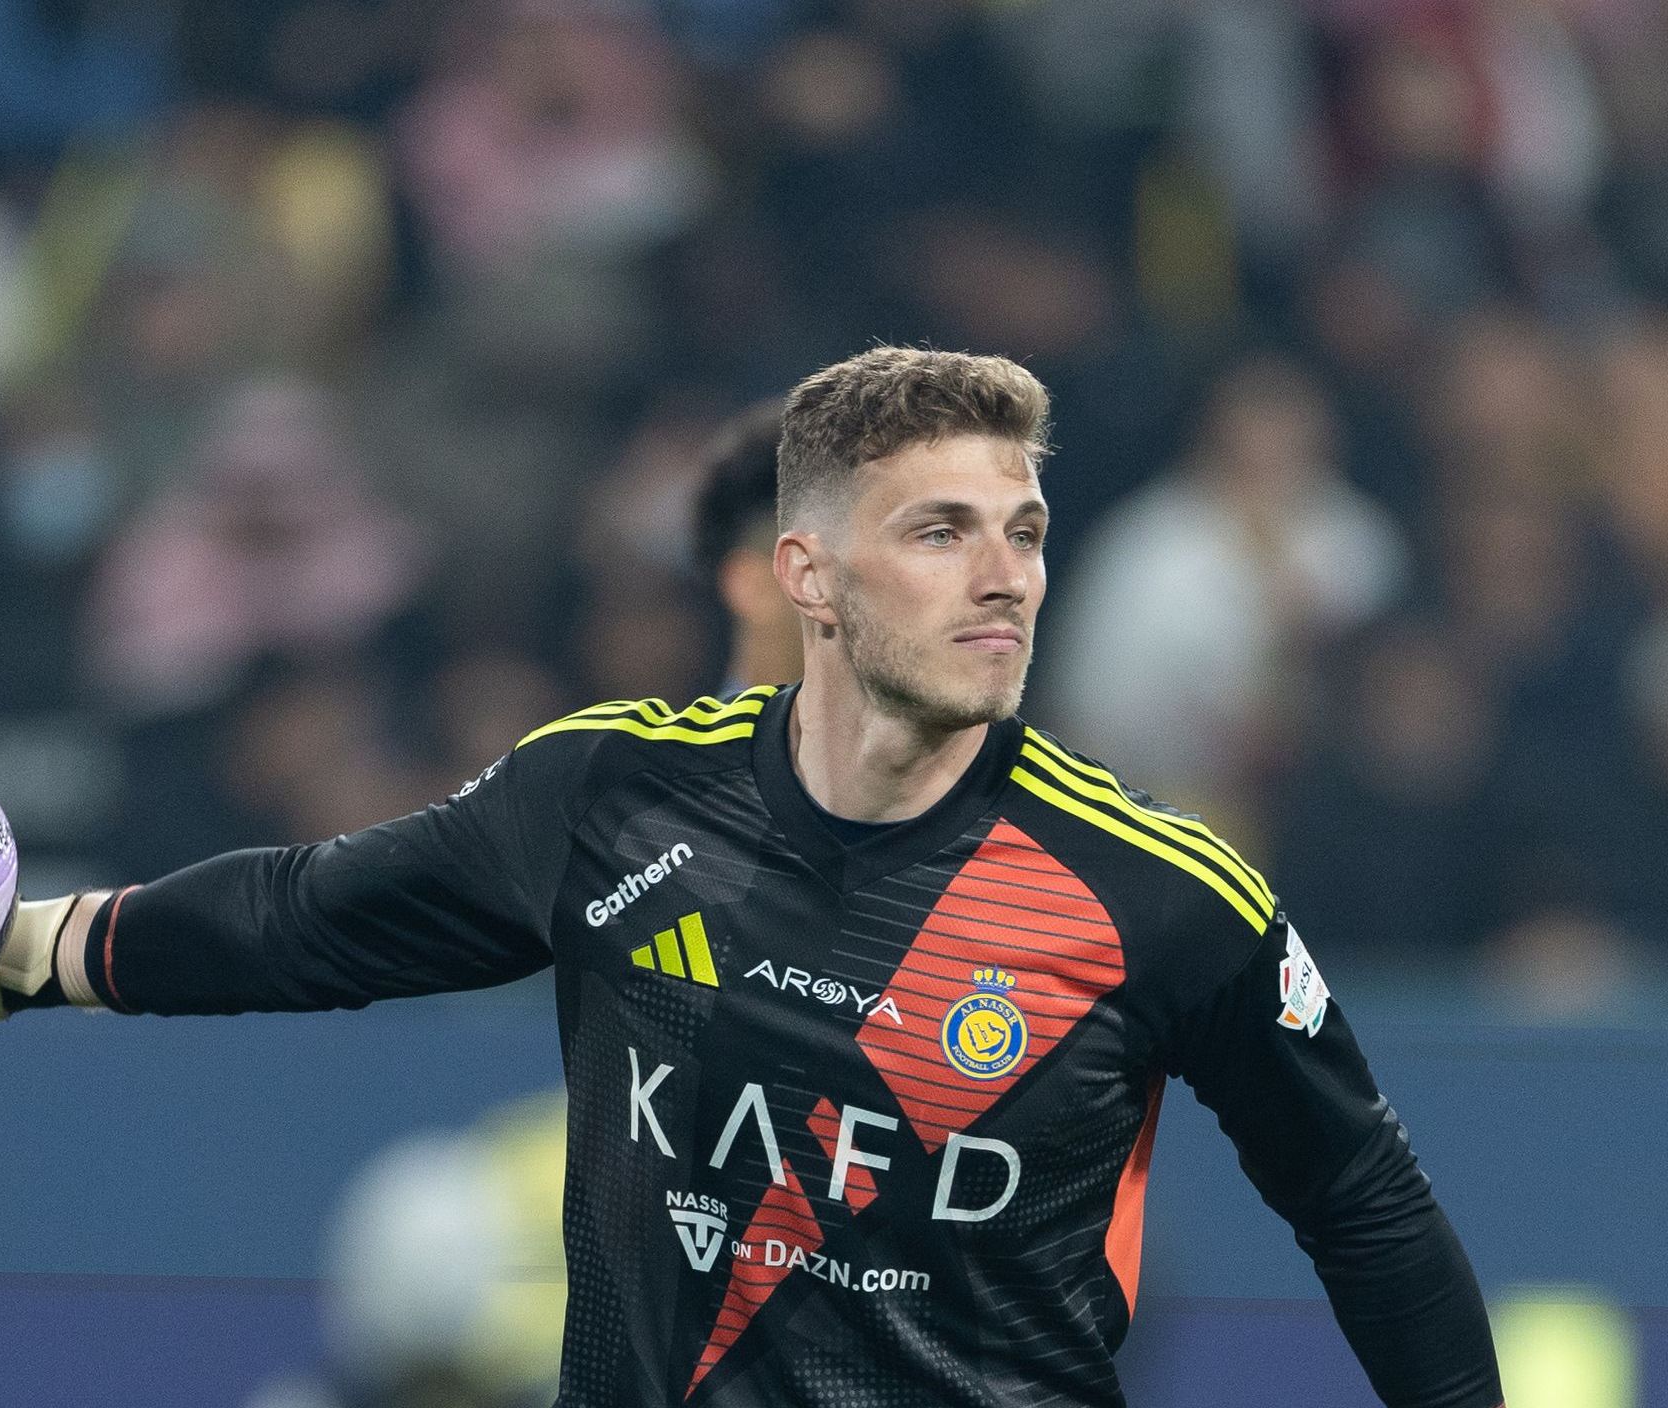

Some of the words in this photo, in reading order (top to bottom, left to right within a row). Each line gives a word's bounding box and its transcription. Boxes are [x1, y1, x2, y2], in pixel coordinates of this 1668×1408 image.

[585, 842, 694, 928] Gathern
[978, 999, 1018, 1027] NASSR
[952, 1045, 990, 1071] FOOTBALL
[992, 1054, 1014, 1070] CLUB
[628, 1045, 1022, 1223] KAFD
[665, 1189, 729, 1221] NASSR
[731, 1240, 752, 1260] ON
[764, 1238, 932, 1293] DAZN.com
